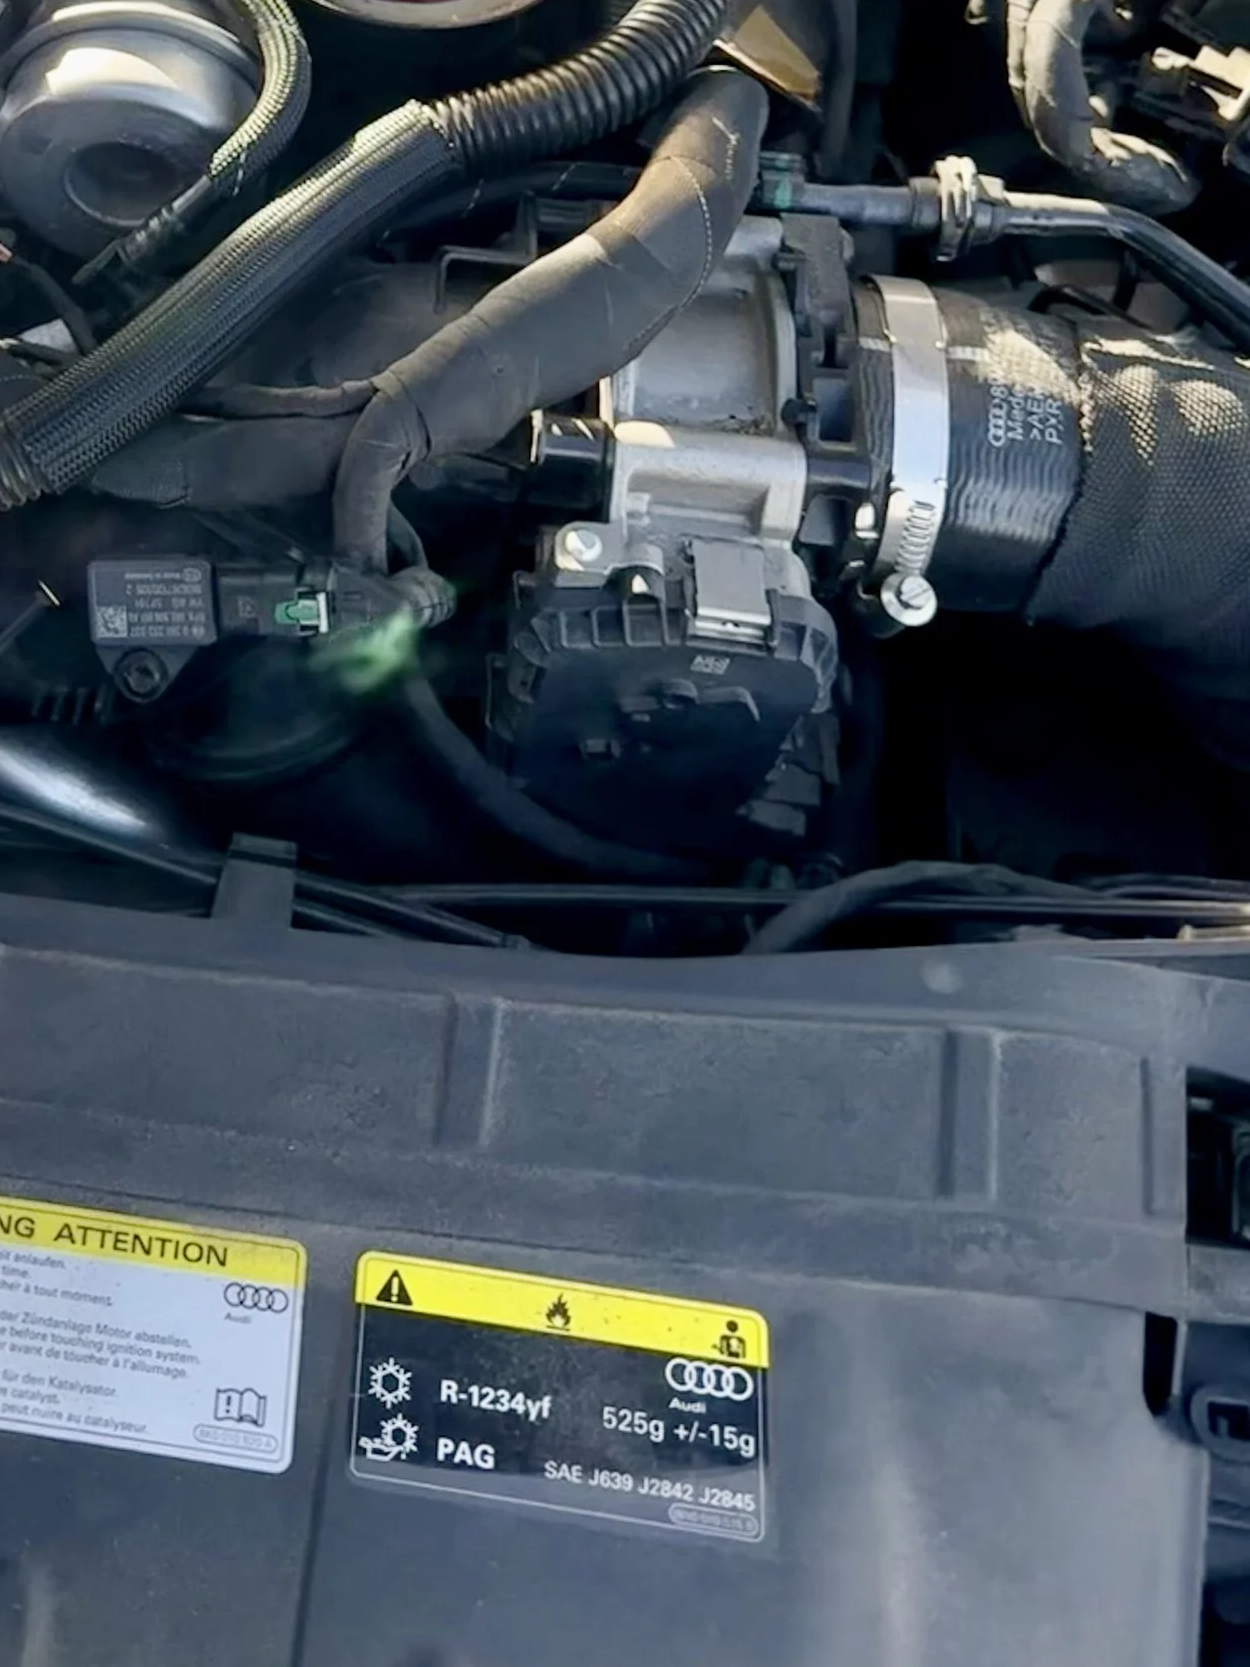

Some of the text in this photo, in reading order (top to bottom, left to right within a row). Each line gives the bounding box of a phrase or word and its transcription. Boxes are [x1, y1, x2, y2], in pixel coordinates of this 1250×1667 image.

[53, 1222, 228, 1267] ATTENTION
[33, 1284, 57, 1298] tout
[60, 1288, 113, 1306] moment.
[20, 1313, 92, 1335] Zündanlage
[95, 1324, 131, 1339] Motor
[224, 1312, 252, 1324] Audi
[8, 1341, 43, 1356] avant
[45, 1346, 61, 1359] de
[63, 1349, 110, 1367] toucher
[9, 1326, 47, 1341] before
[49, 1332, 103, 1352] touching
[106, 1340, 152, 1359] ignition
[1, 1368, 19, 1382] für
[20, 1372, 45, 1386] den
[0, 1401, 29, 1416] peut
[32, 1406, 63, 1420] nuire
[66, 1412, 81, 1423] au
[440, 1379, 552, 1421] R-1234yf
[669, 1397, 707, 1415] Audi
[602, 1406, 755, 1458] 525g +/-15g
[437, 1437, 496, 1470] PAG
[544, 1461, 757, 1512] SAE J639 J2842 J2845
